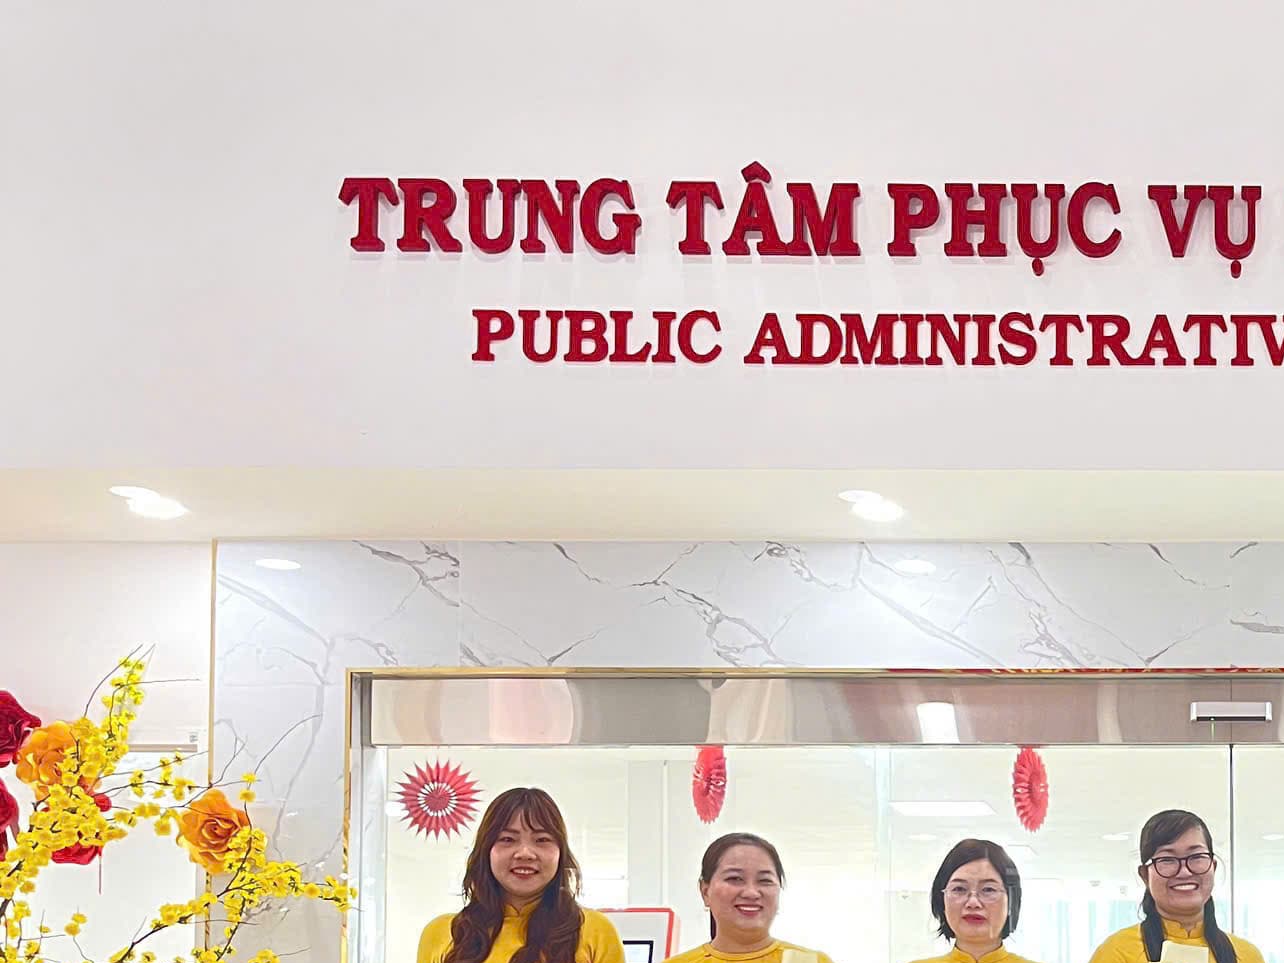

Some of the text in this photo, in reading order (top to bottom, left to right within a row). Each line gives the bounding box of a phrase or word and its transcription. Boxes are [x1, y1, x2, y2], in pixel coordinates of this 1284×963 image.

[340, 178, 640, 254] TRUNG
[667, 163, 860, 256] TÂM
[888, 183, 1121, 276] PHỤC
[1148, 186, 1261, 277] VỤ
[472, 310, 722, 364] PUBLIC
